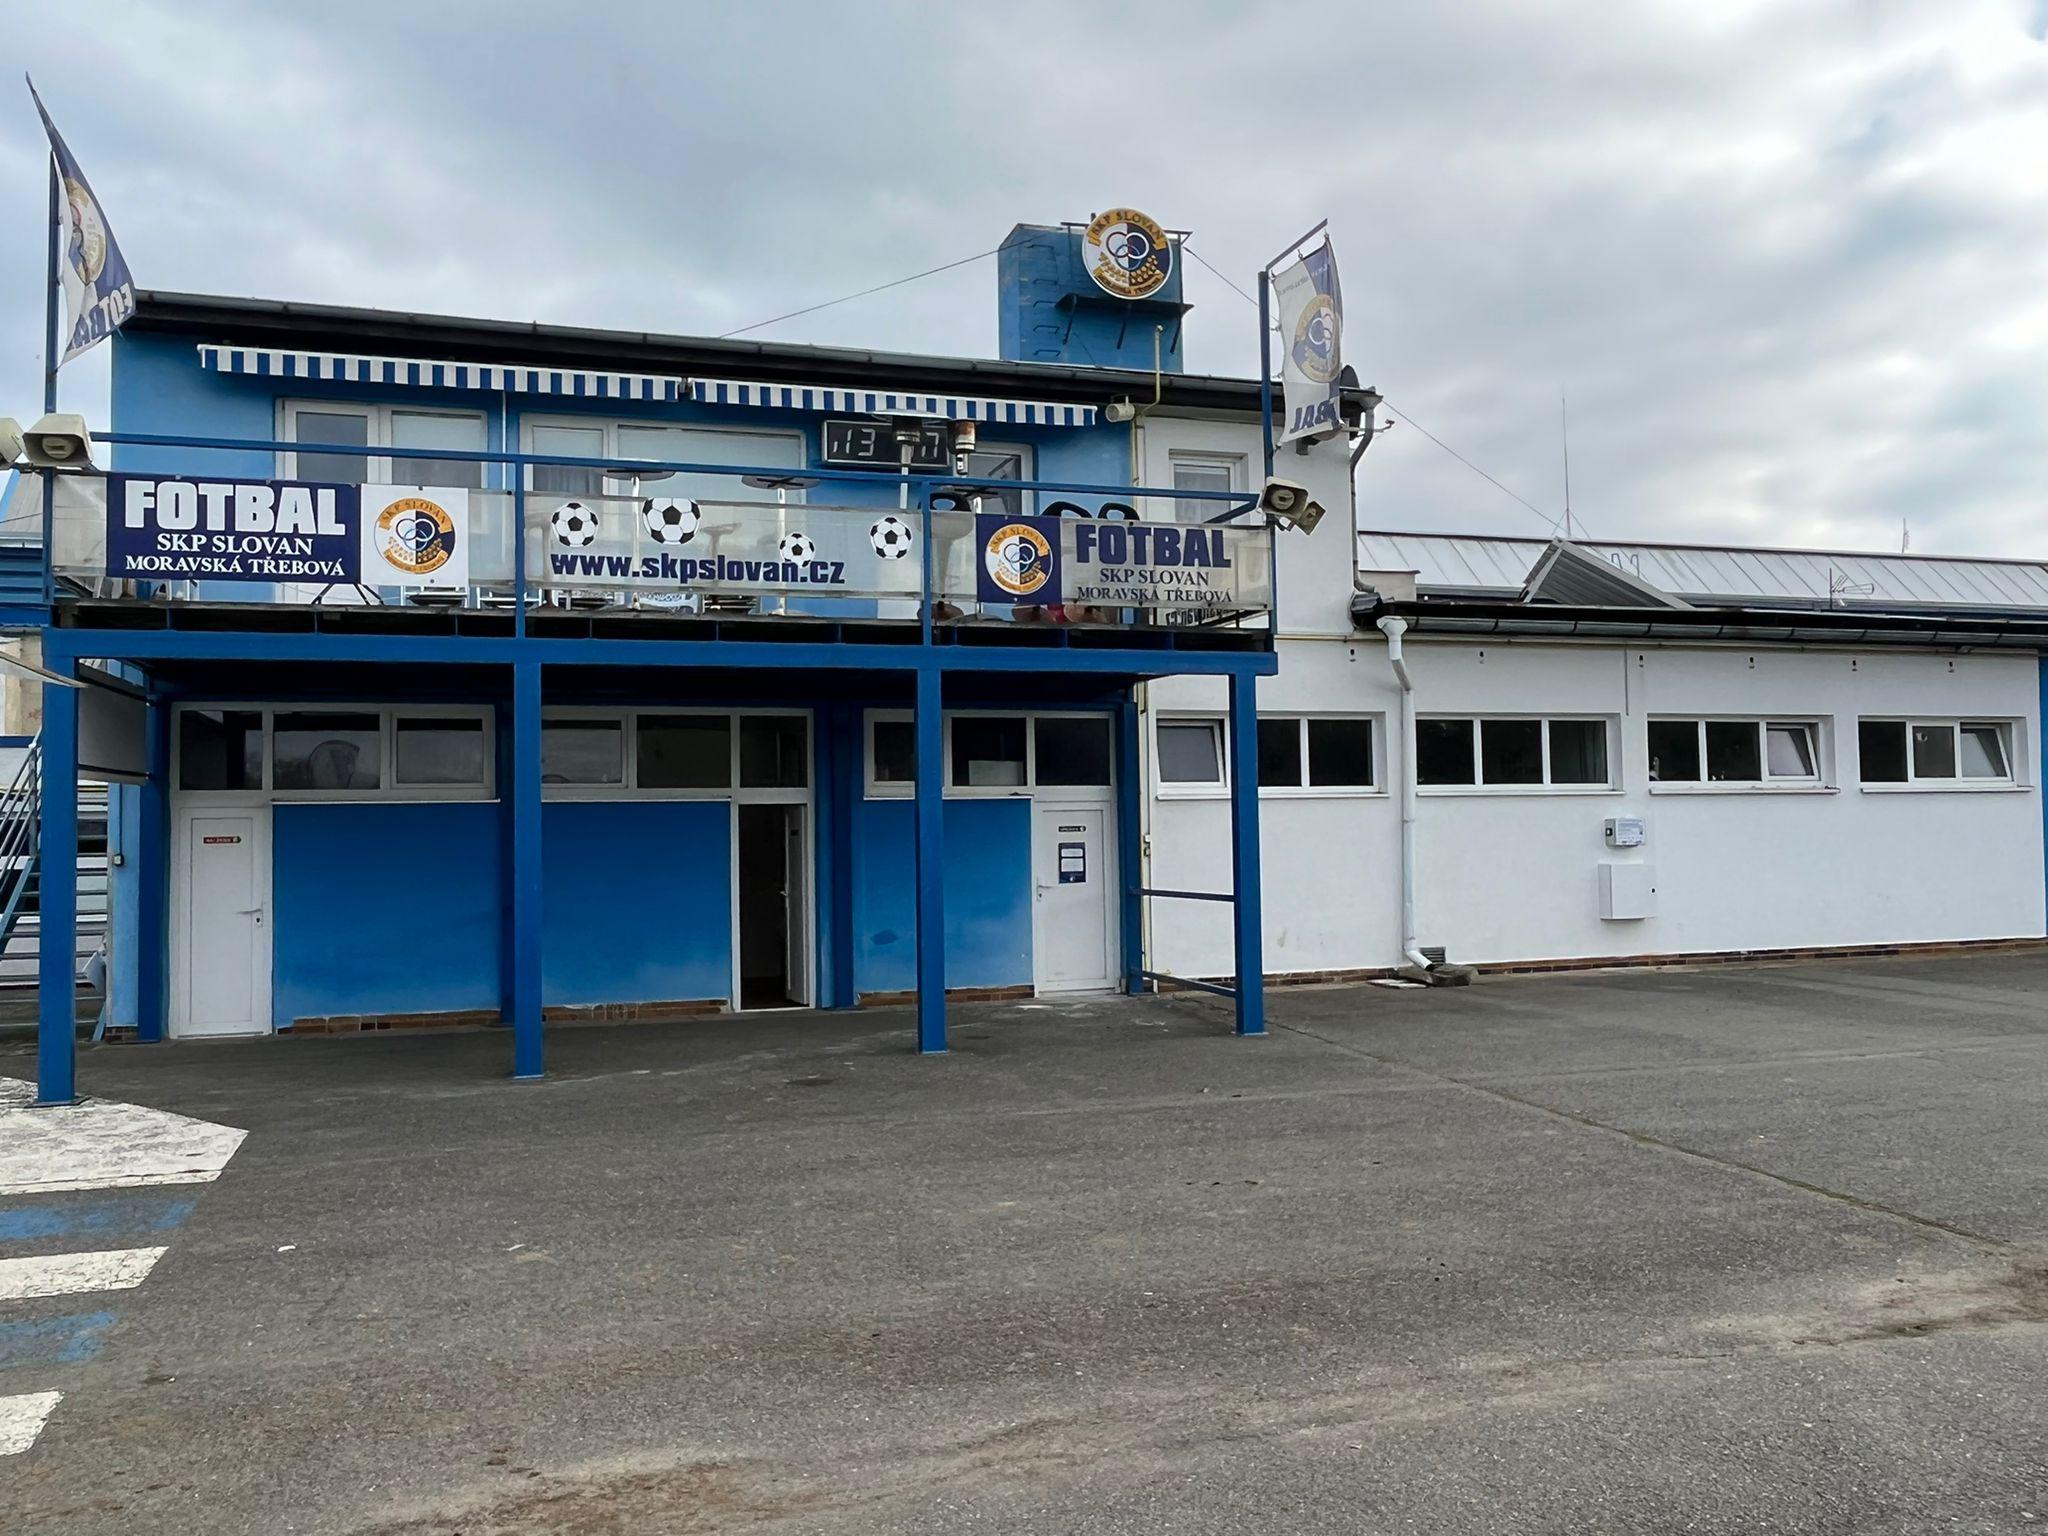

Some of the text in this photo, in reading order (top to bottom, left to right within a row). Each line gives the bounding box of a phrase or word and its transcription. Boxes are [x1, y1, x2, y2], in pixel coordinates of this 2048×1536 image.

[1117, 211, 1166, 240] SLOVAN
[125, 480, 346, 535] FOTBAL
[157, 533, 314, 555] SKP SLOVAN
[1075, 524, 1232, 568] FOTBAL
[125, 555, 345, 576] MORAVSKÁ TŘEBOVÁ
[550, 553, 845, 584] www.skpslovan.cz
[1100, 568, 1210, 586] SKP SLOVAN
[1077, 585, 1232, 603] MORAVSKÁ TŘEBOVÁ
